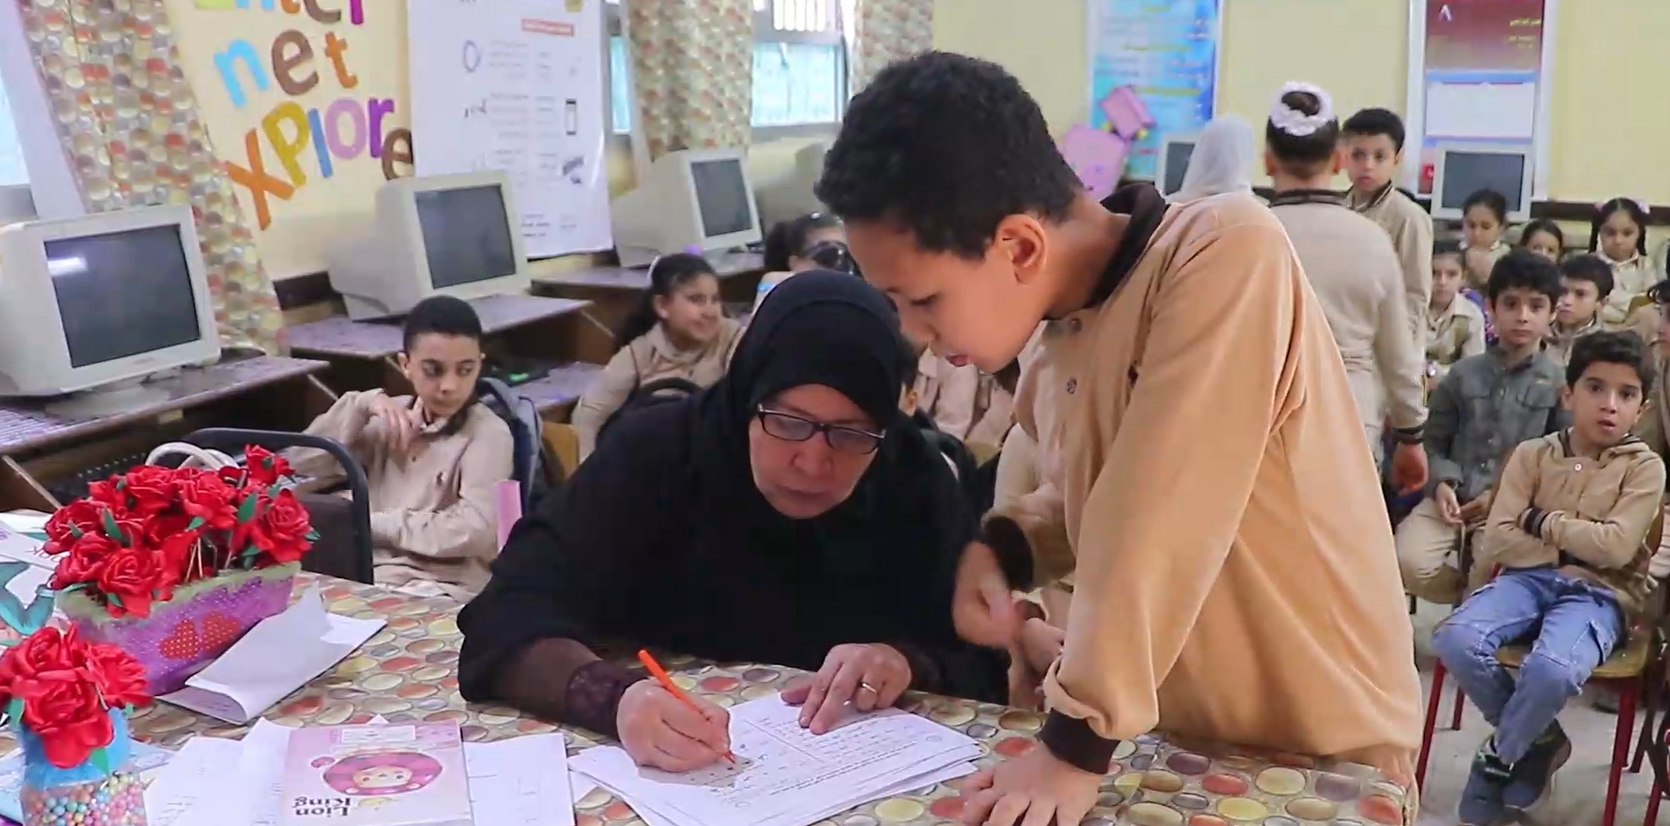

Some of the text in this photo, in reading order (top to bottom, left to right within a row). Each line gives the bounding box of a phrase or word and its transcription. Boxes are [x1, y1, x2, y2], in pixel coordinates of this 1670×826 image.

[213, 29, 358, 107] net
[292, 796, 351, 808] King
[295, 806, 348, 817] Lion
